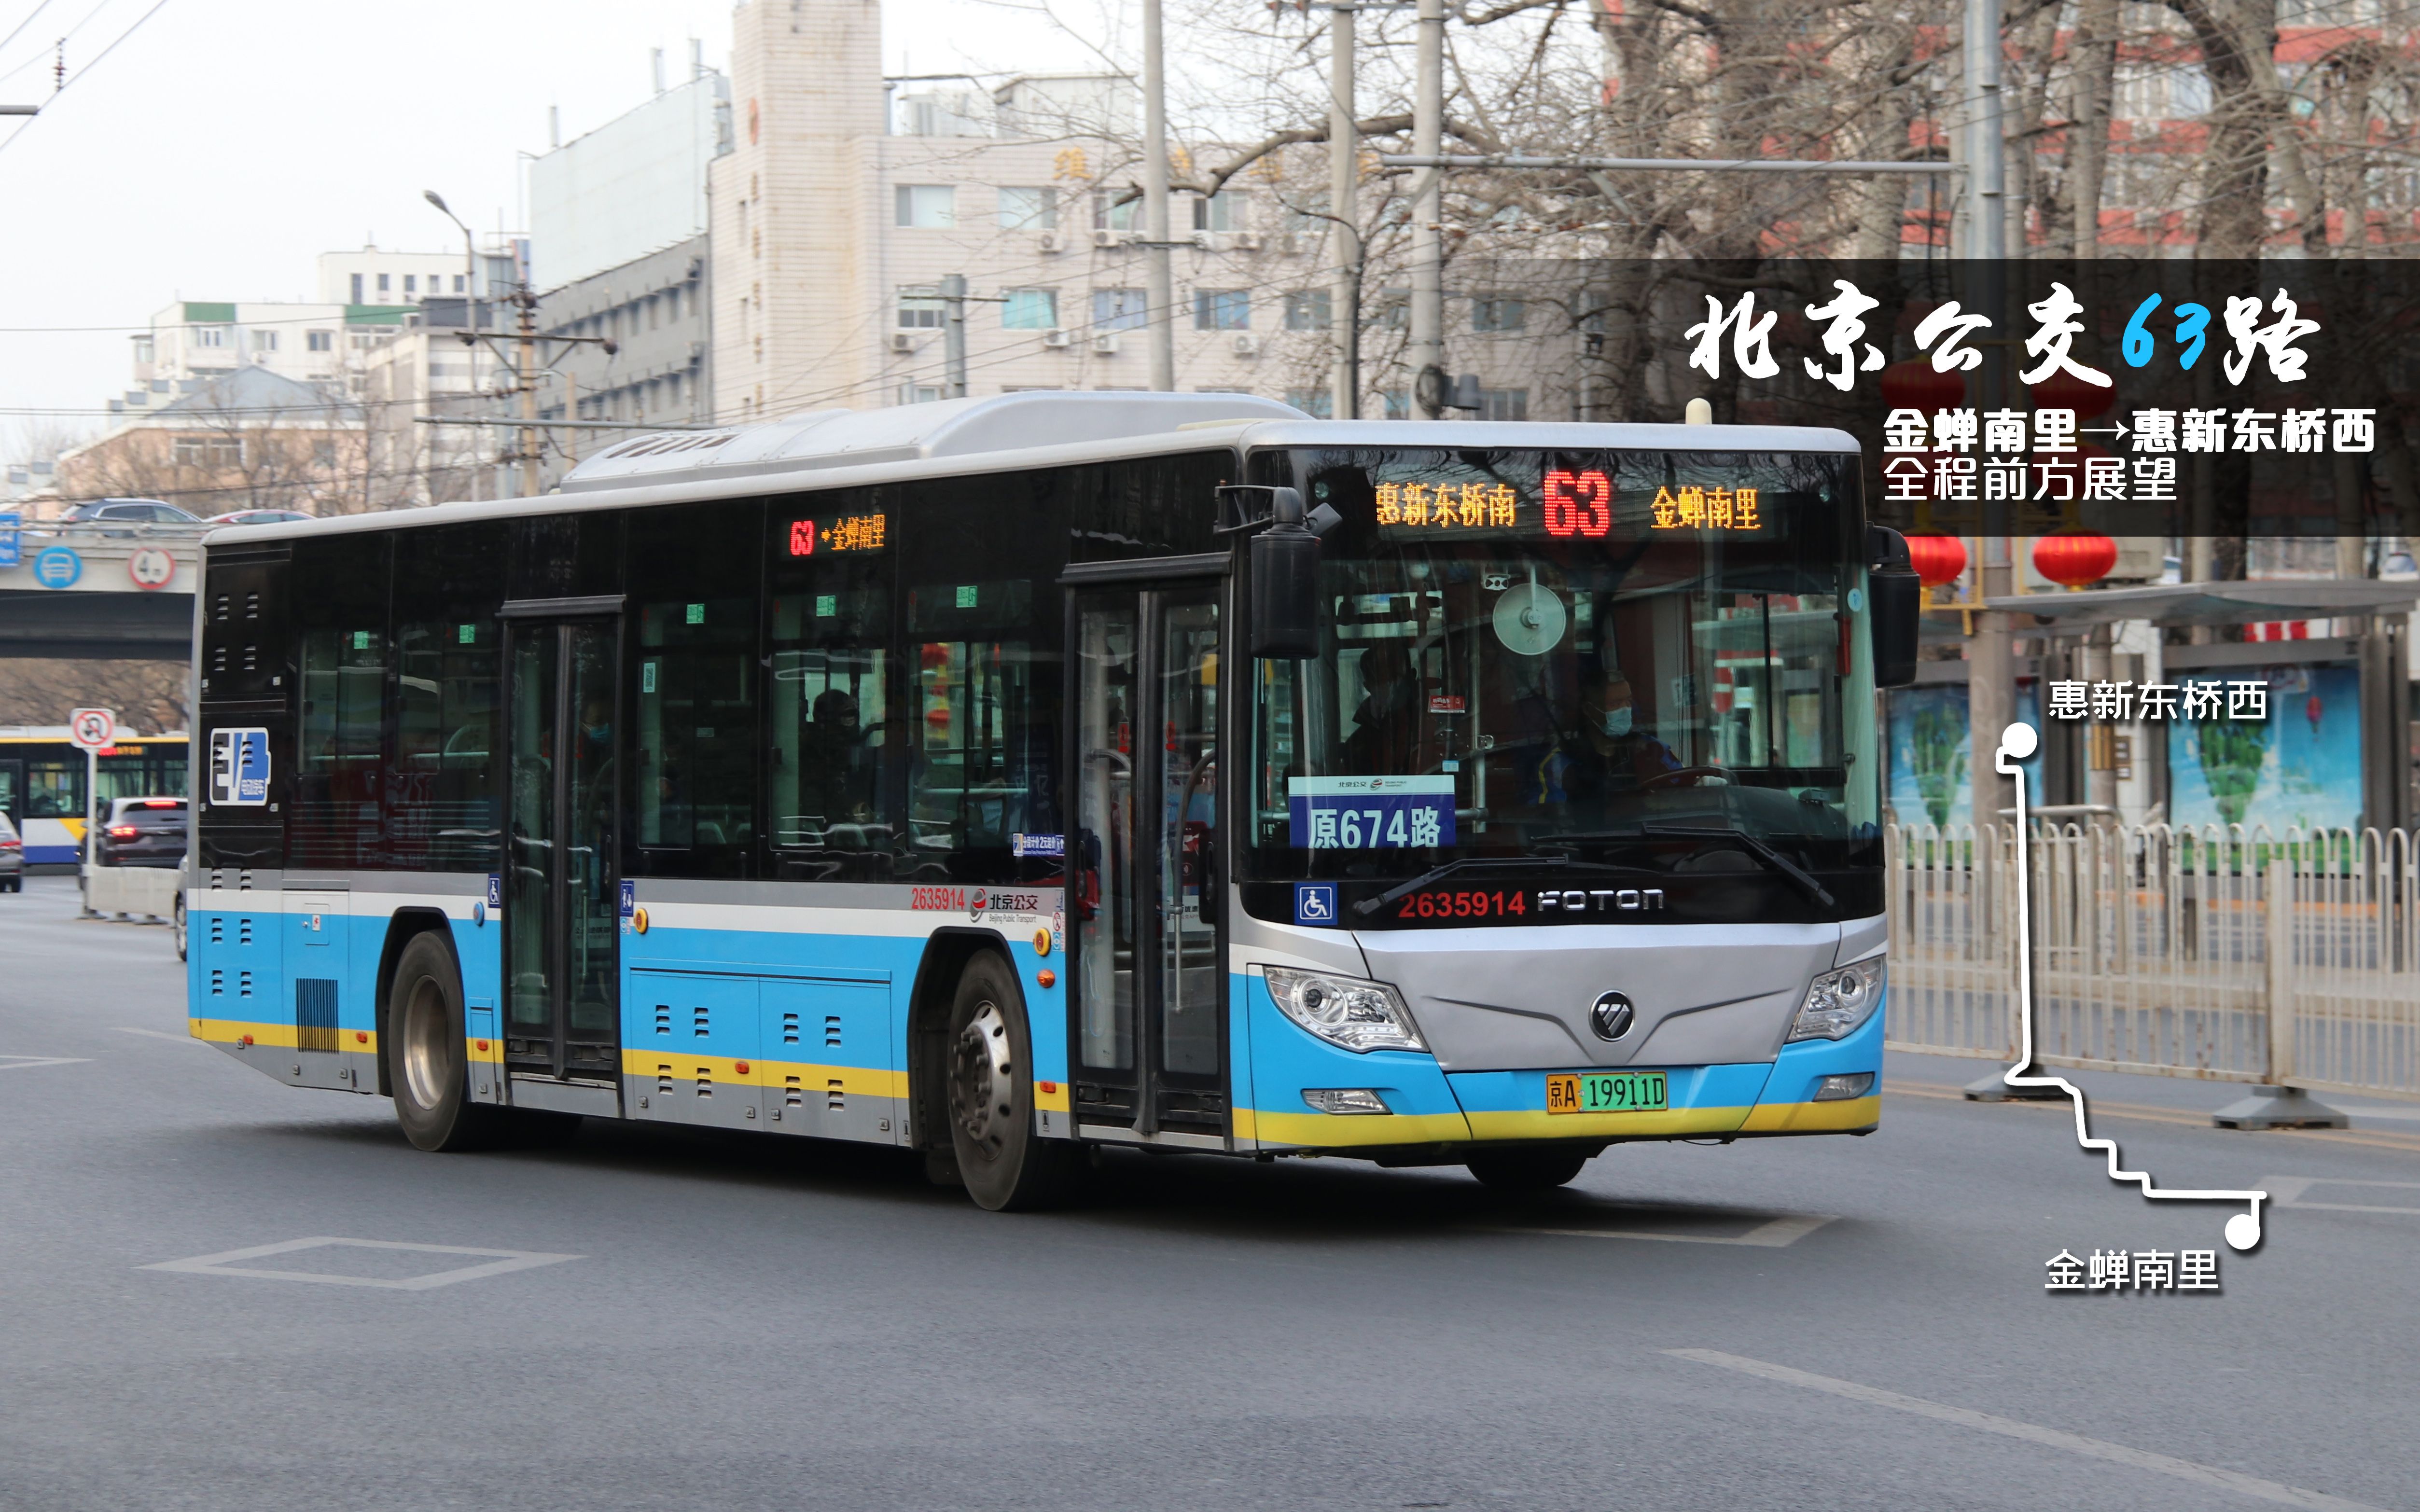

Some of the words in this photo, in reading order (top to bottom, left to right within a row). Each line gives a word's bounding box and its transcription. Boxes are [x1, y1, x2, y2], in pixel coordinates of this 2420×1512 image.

[1375, 482, 1515, 527] 惠新东桥南
[1544, 471, 1611, 536] 63
[1651, 486, 1761, 529] 金蝉南里
[791, 521, 814, 555] 63
[831, 513, 885, 551] 金蝉南里
[1308, 805, 1441, 849] 原674路
[911, 888, 965, 910] 2635914
[989, 894, 1038, 910] 北京公交
[1398, 891, 1526, 917] 2635914
[1537, 888, 1664, 911] FOTON
[989, 914, 1002, 924] Beijing
[1003, 914, 1015, 923] Public
[1015, 914, 1037, 924] Transport
